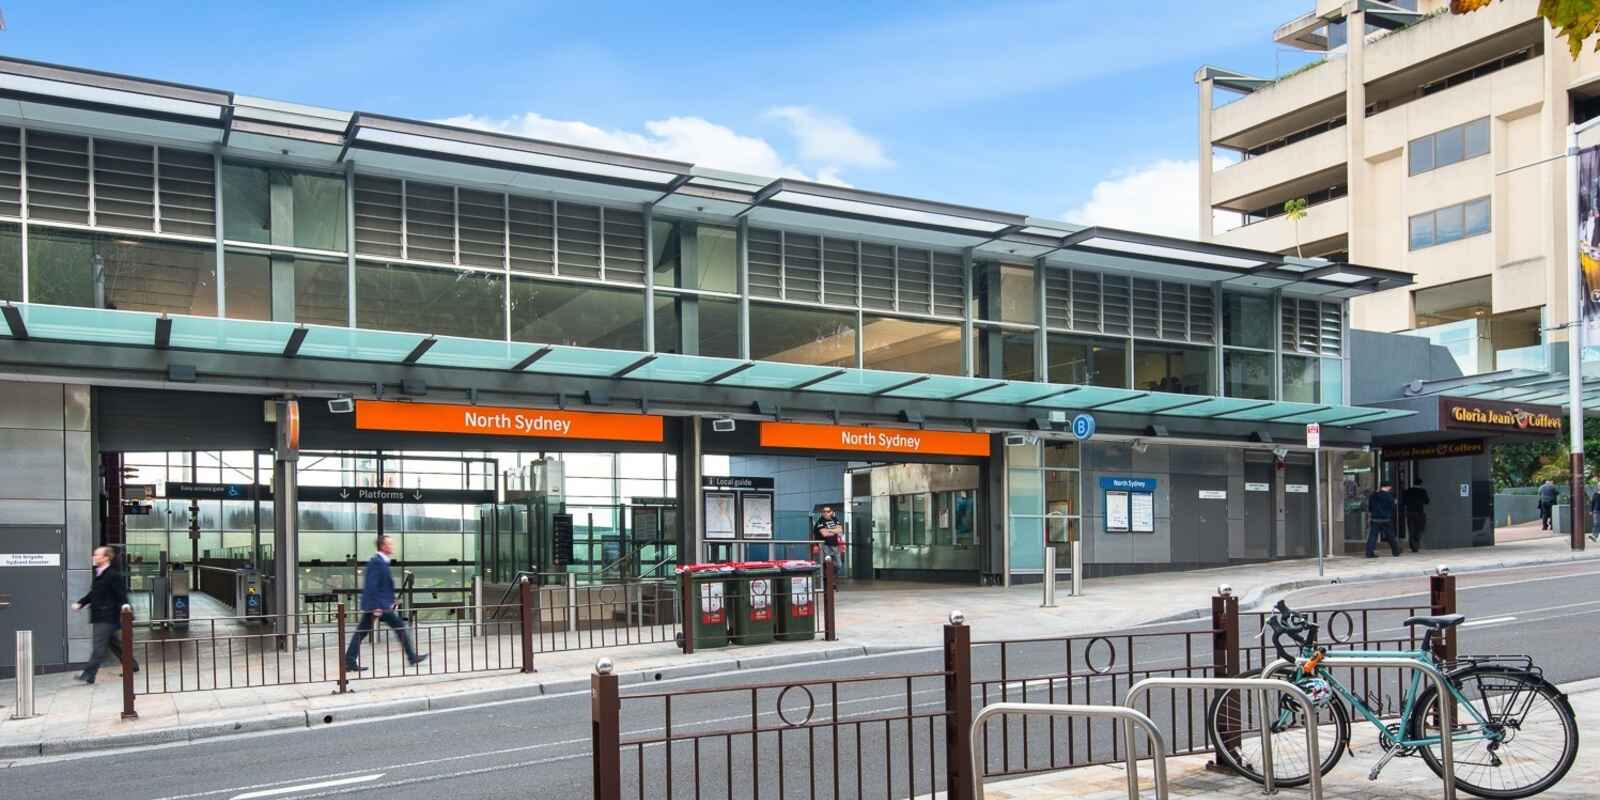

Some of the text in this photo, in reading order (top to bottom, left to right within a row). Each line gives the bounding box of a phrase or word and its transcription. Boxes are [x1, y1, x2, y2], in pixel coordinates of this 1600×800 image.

[1452, 406, 1487, 423] Gloria
[464, 411, 571, 434] North Sydney
[1077, 420, 1086, 434] B
[841, 431, 920, 450] North Sydney
[716, 477, 752, 488] Local guide
[1113, 479, 1146, 489] North Sydney
[359, 489, 405, 500] Platforms
